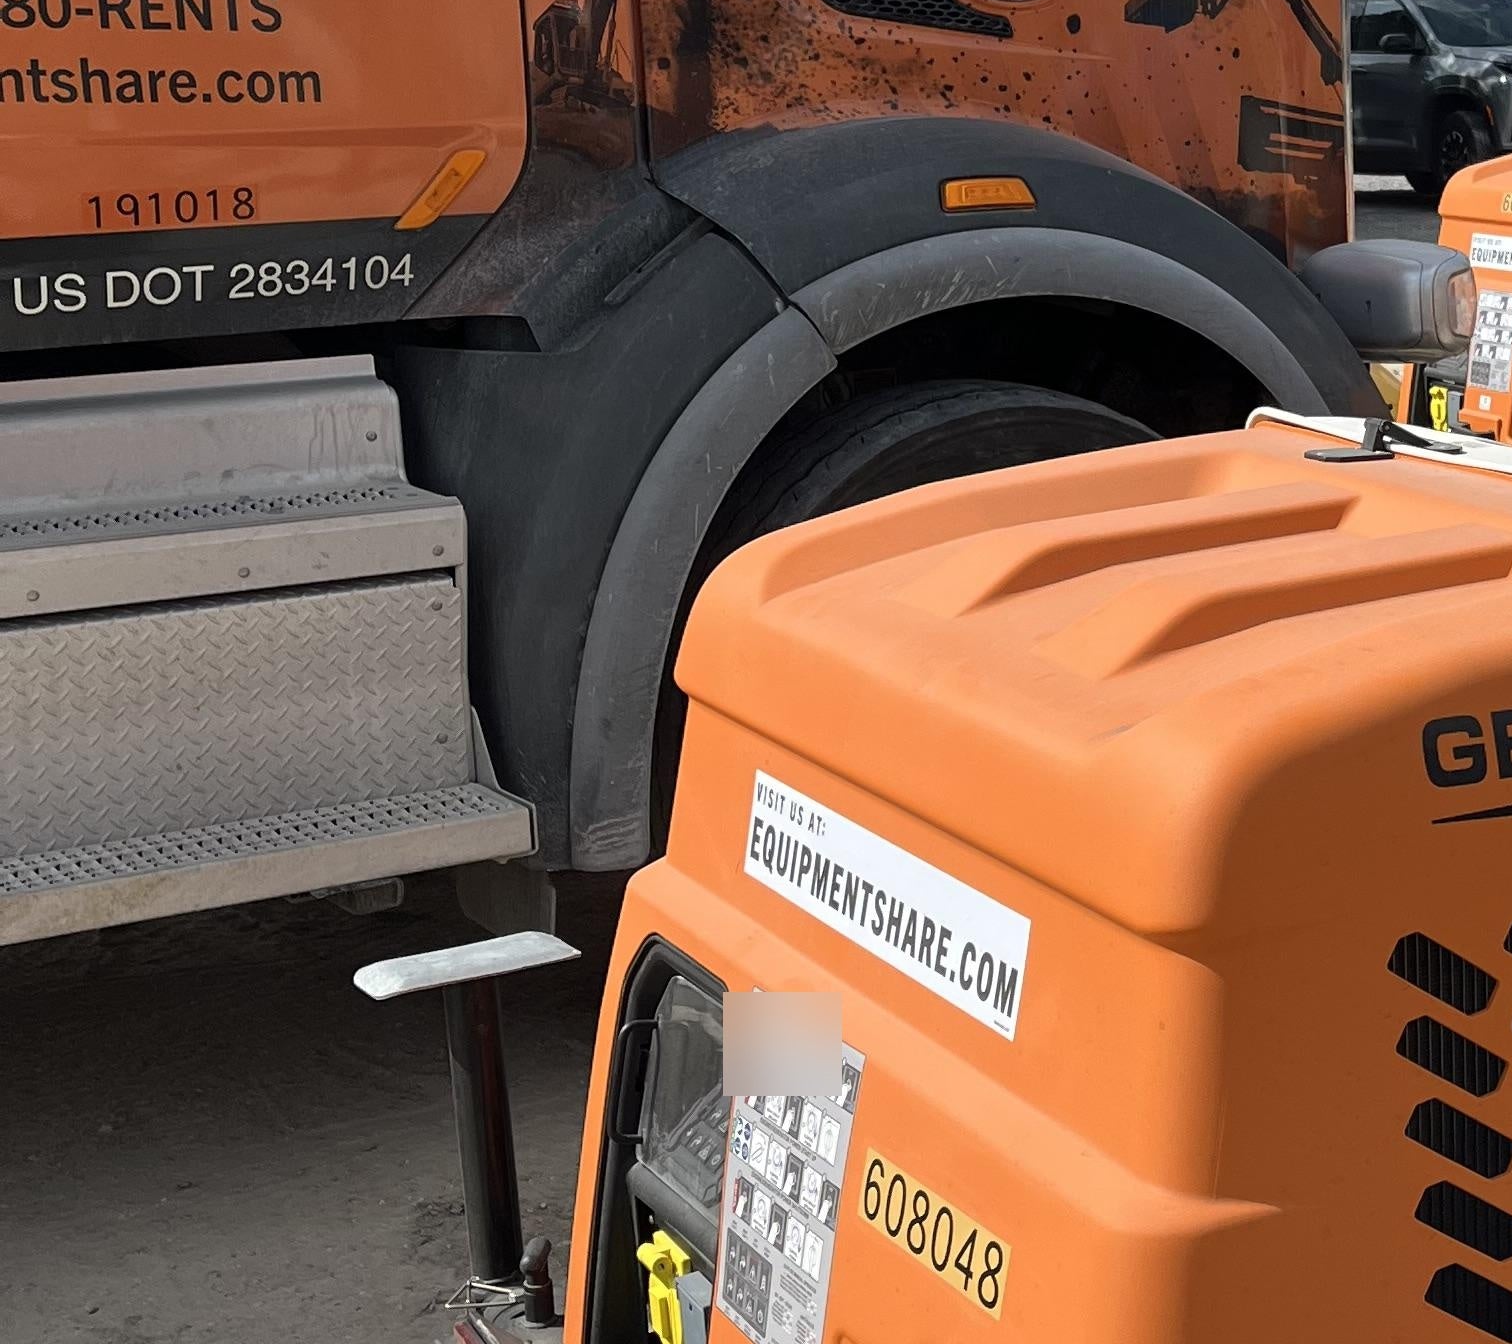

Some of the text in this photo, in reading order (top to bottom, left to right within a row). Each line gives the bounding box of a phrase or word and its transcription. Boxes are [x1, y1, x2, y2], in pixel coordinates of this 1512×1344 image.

[87, 187, 256, 228] 191018
[13, 253, 414, 315] US DOT 2834104
[757, 782, 826, 836] VISIT US AT:
[750, 816, 1018, 1018] EQUIPMENTSHARE.COM
[863, 1158, 1002, 1311] 608048
